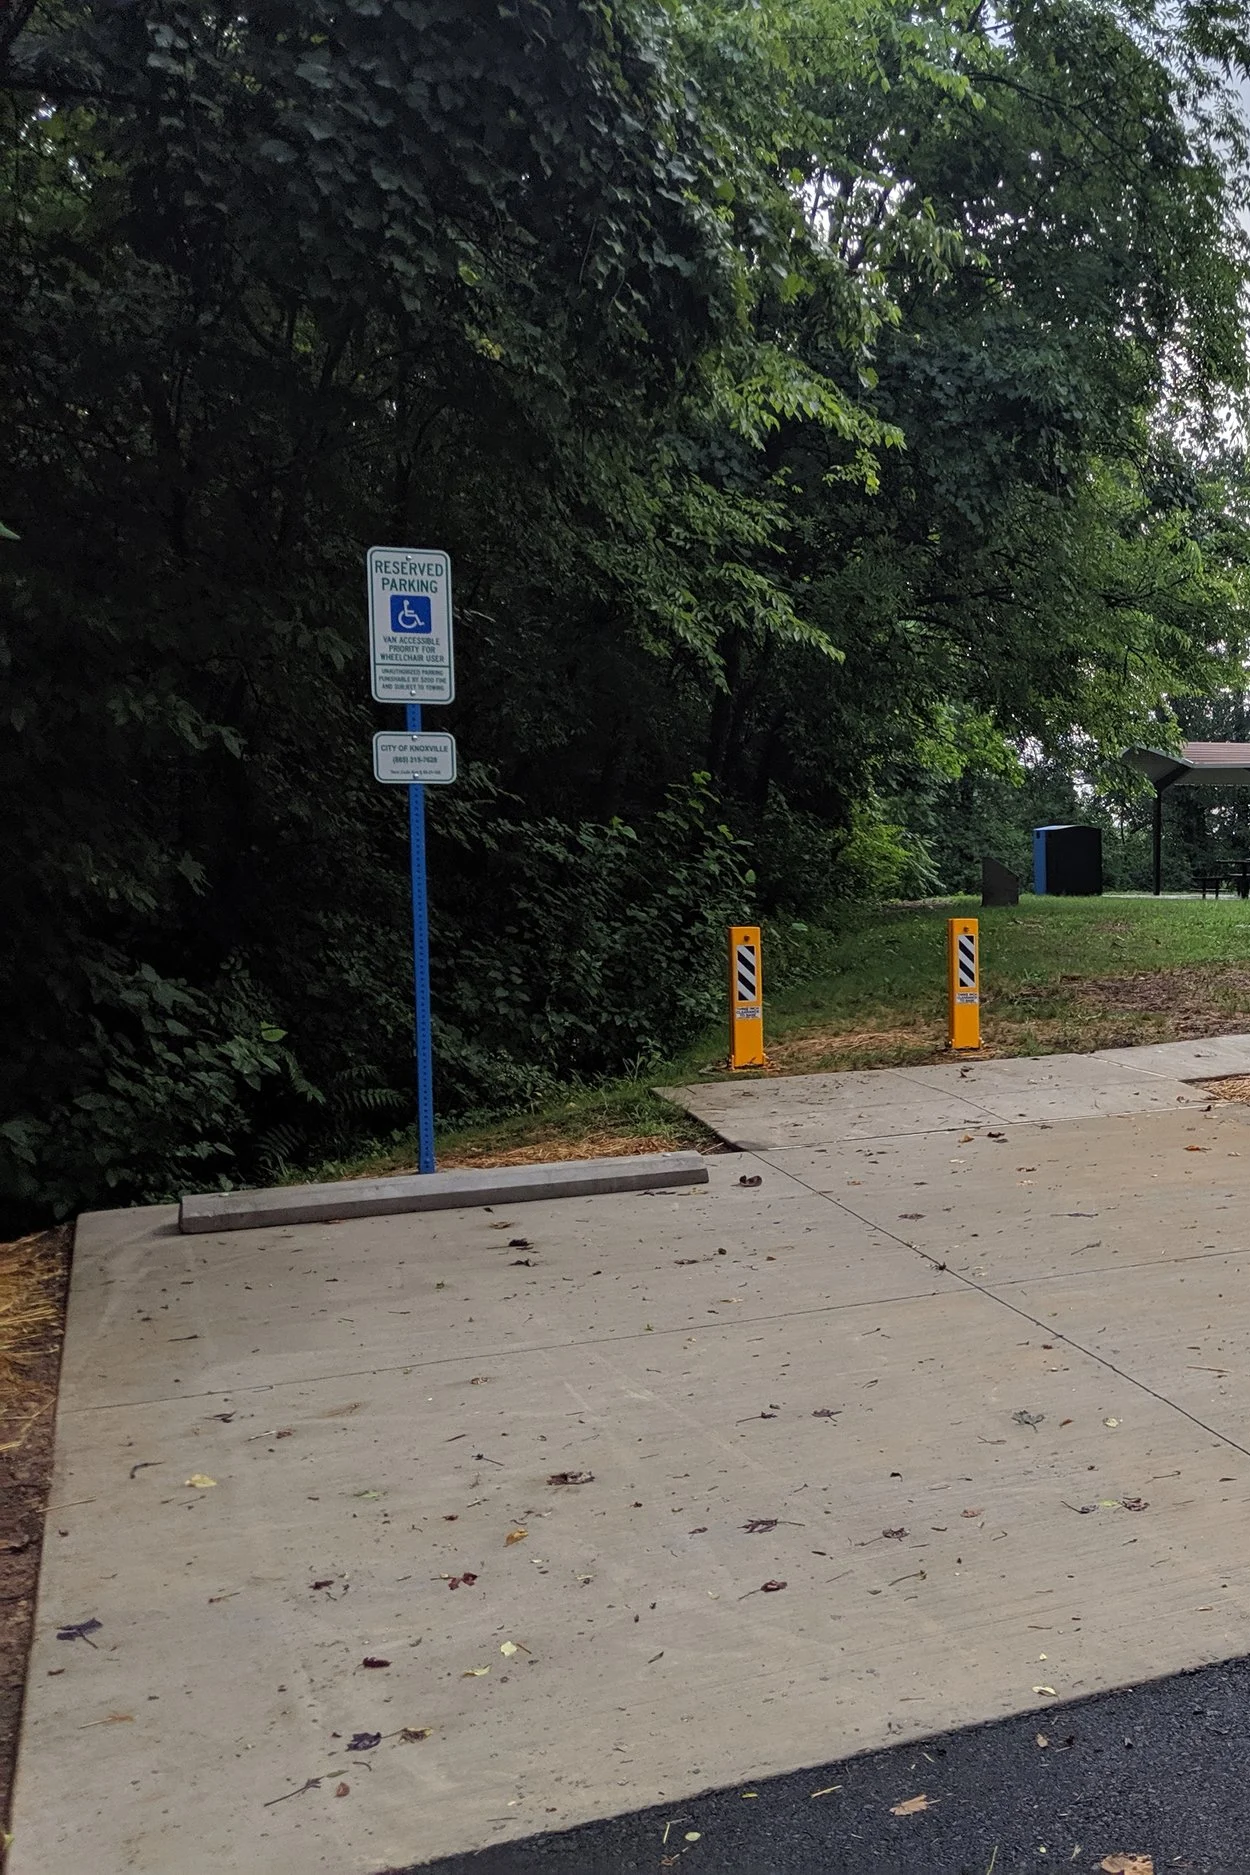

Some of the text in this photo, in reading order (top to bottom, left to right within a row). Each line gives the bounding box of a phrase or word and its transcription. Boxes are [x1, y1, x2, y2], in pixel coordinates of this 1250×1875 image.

[375, 560, 444, 577] RESERVED
[382, 578, 438, 594] PARKING
[399, 637, 440, 646] ACCESSIBLE
[380, 654, 424, 662] WHEELCHAIR
